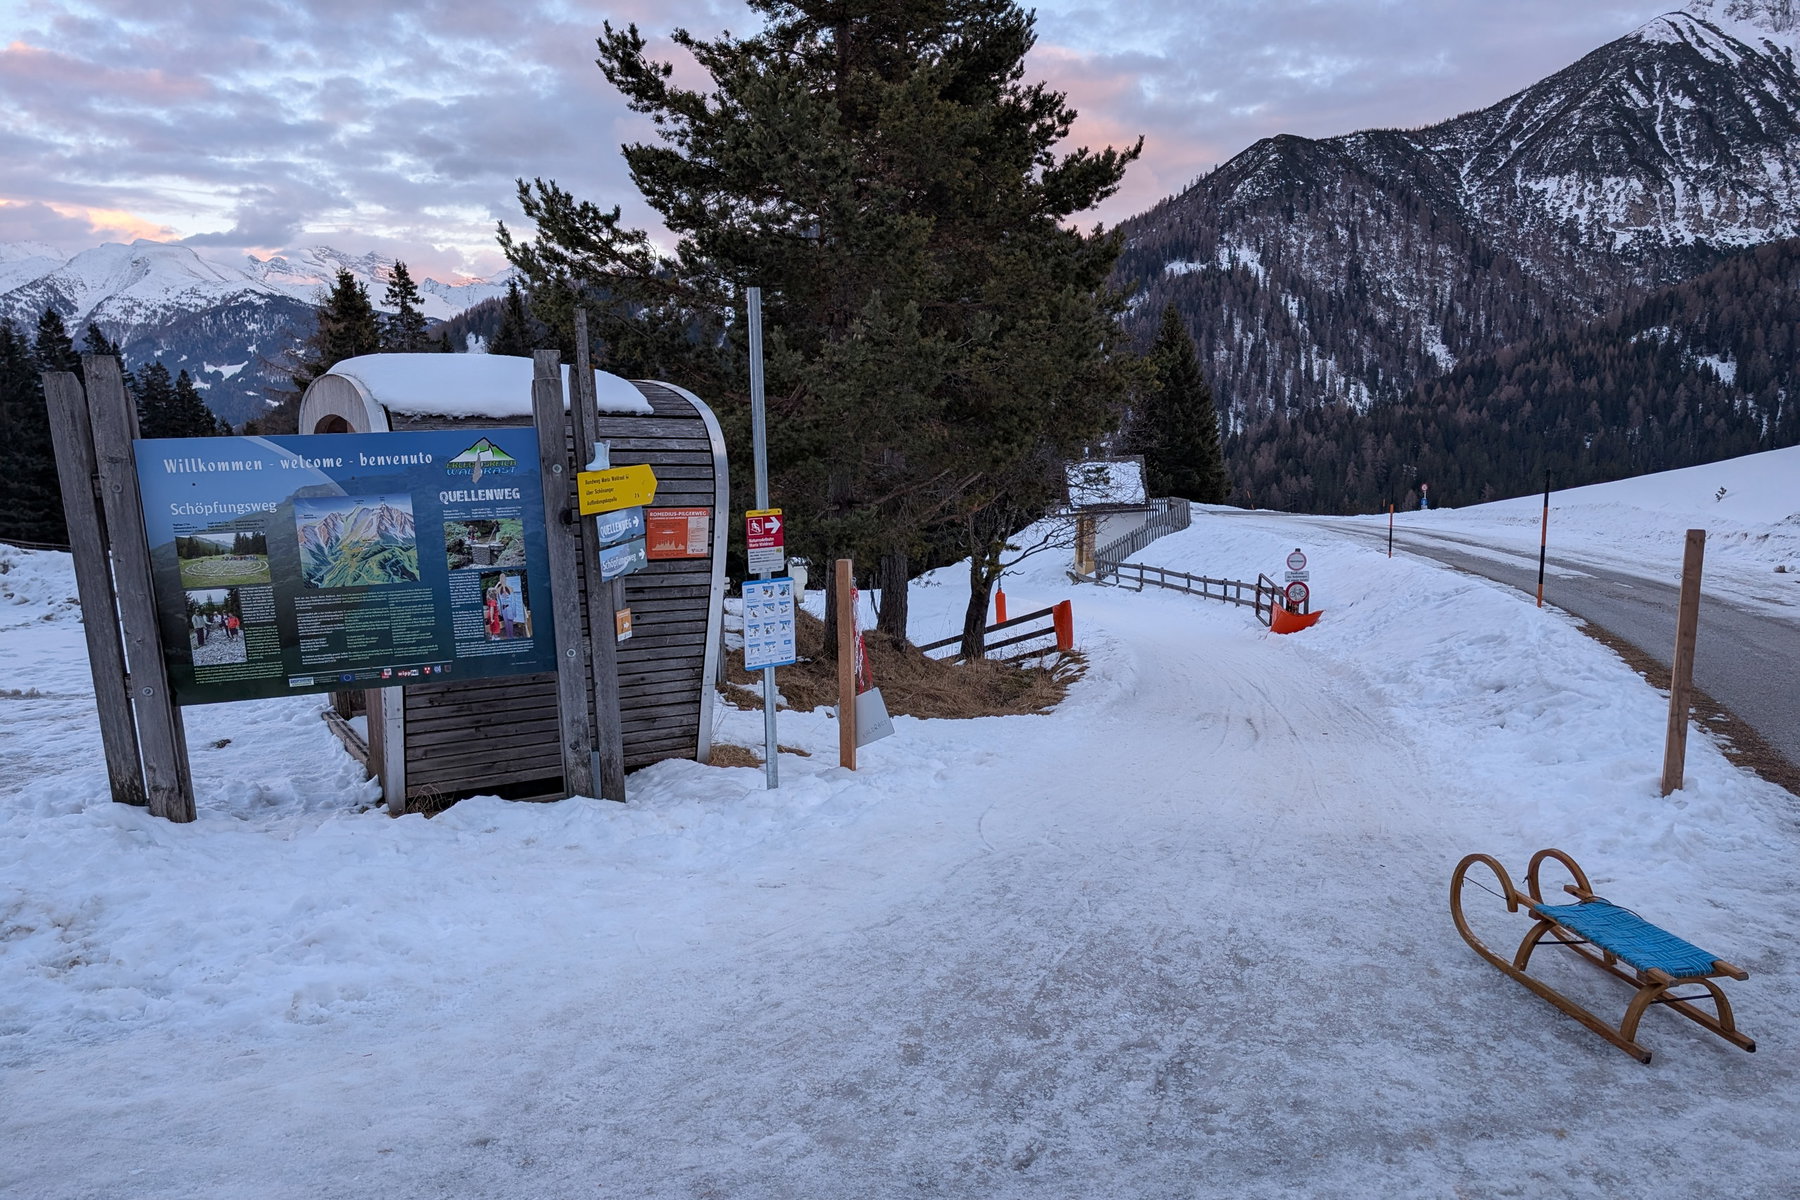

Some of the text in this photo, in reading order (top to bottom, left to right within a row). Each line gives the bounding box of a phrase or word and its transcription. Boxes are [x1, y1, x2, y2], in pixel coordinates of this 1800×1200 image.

[163, 457, 263, 474] Willkommen
[280, 455, 344, 470] welcome
[359, 452, 433, 467] benvenuto
[439, 487, 521, 504] QUELLENWEG
[170, 501, 278, 516] Schöpfungsweg
[600, 518, 633, 538] QUELLENWEG
